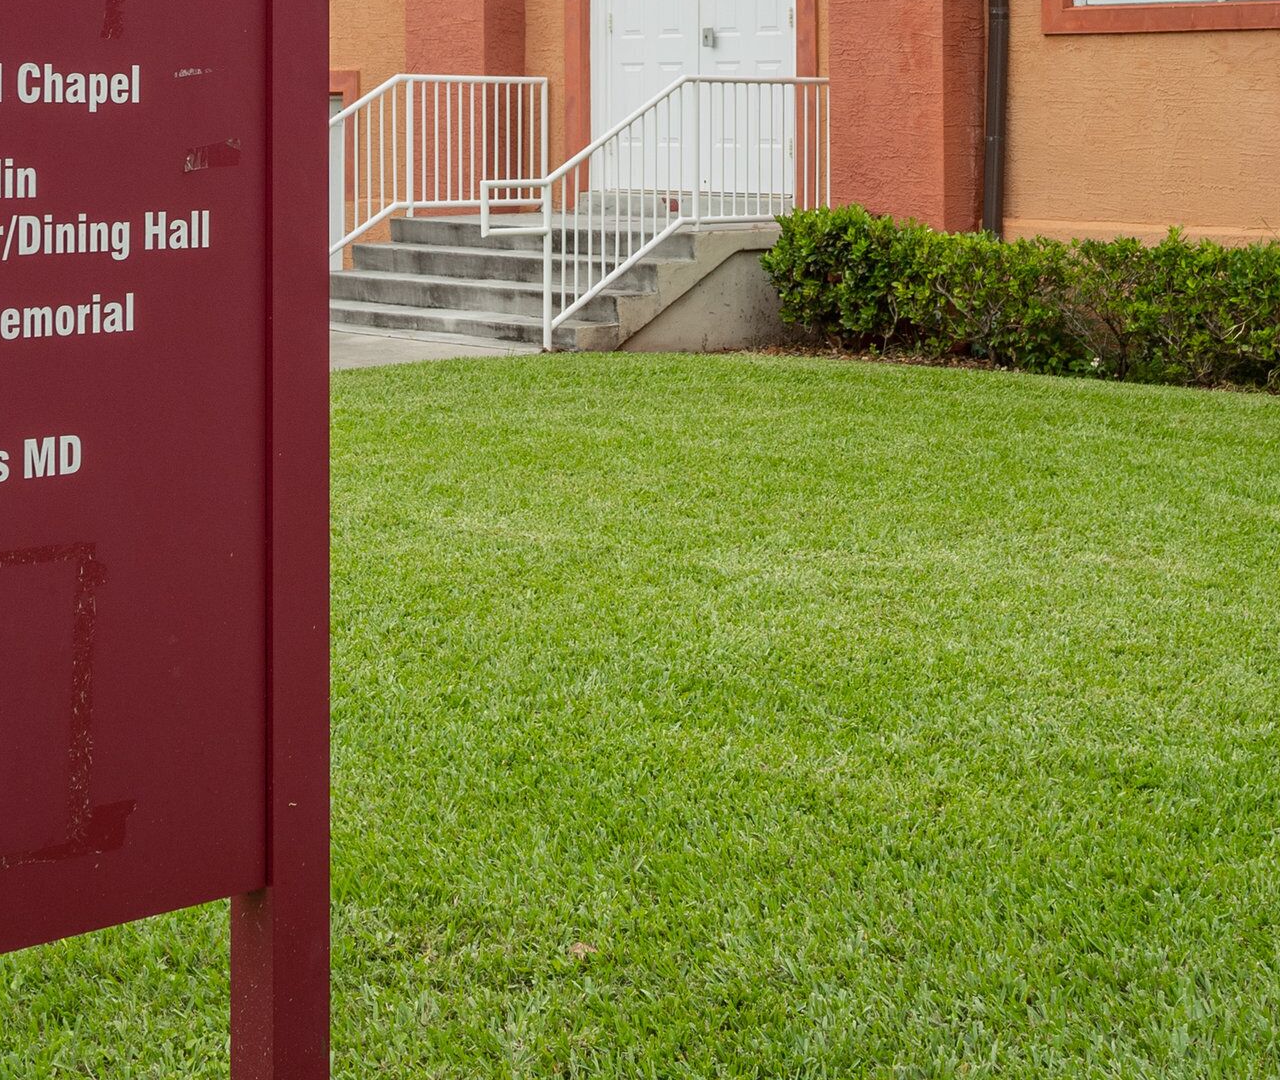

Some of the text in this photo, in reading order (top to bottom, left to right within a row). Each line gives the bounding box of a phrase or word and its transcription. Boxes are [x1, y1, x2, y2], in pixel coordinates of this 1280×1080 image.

[17, 62, 140, 113] Chapel
[144, 209, 210, 251] Hall
[23, 434, 82, 479] MD
